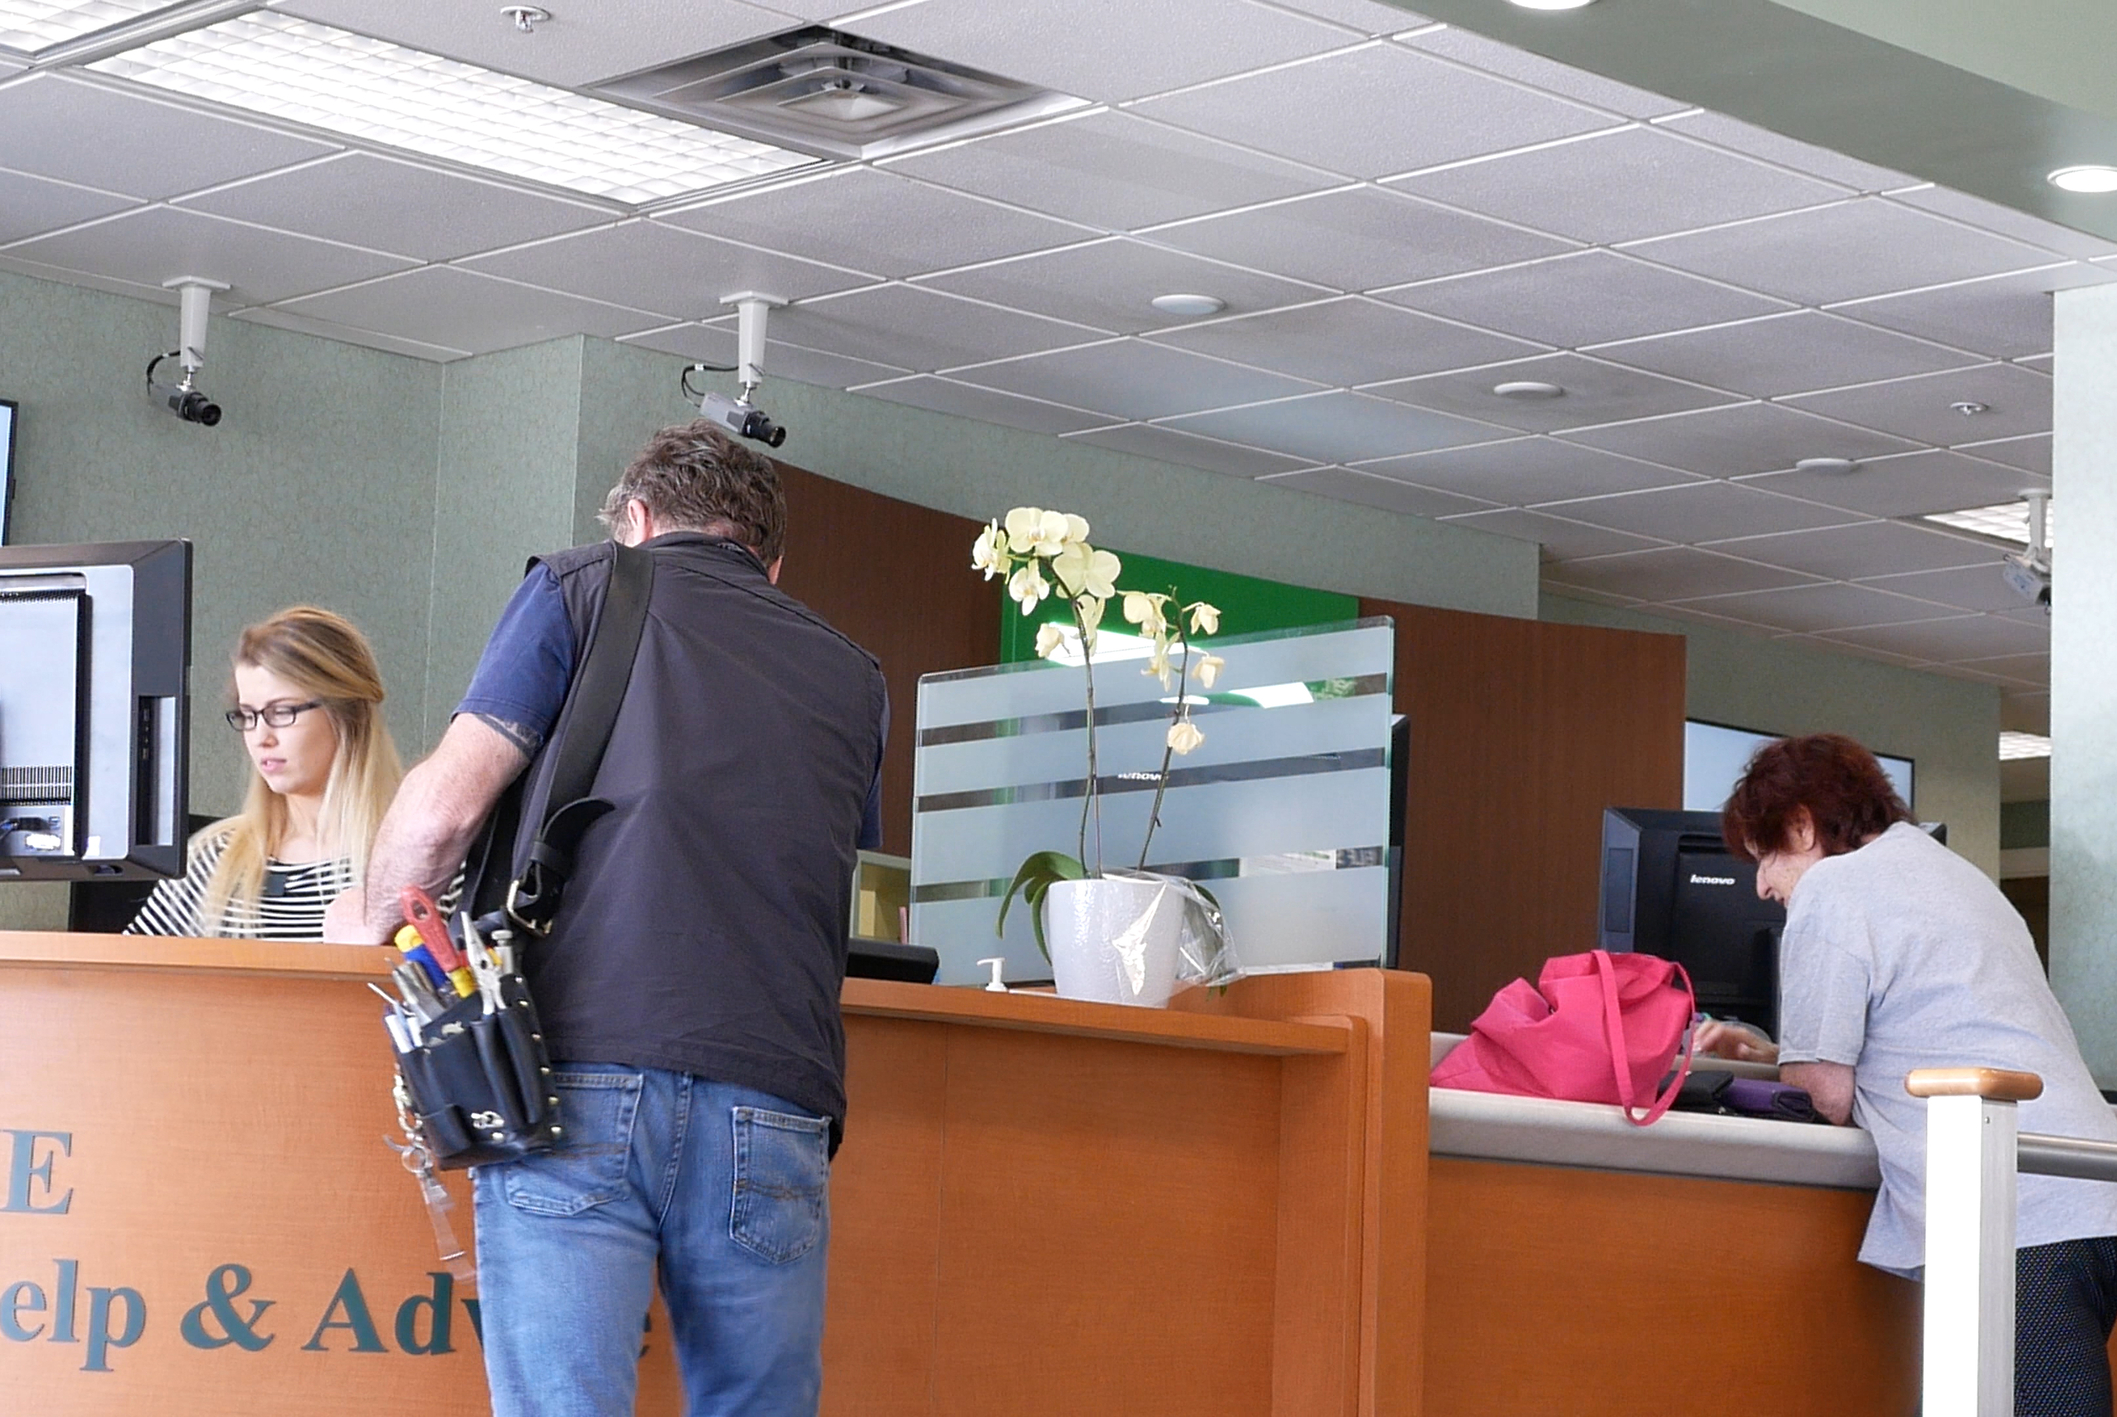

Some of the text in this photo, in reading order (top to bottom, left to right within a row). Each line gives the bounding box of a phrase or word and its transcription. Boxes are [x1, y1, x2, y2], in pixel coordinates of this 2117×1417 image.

[1690, 874, 1736, 885] lenovo
[0, 1129, 74, 1214] E
[180, 1263, 276, 1352] &
